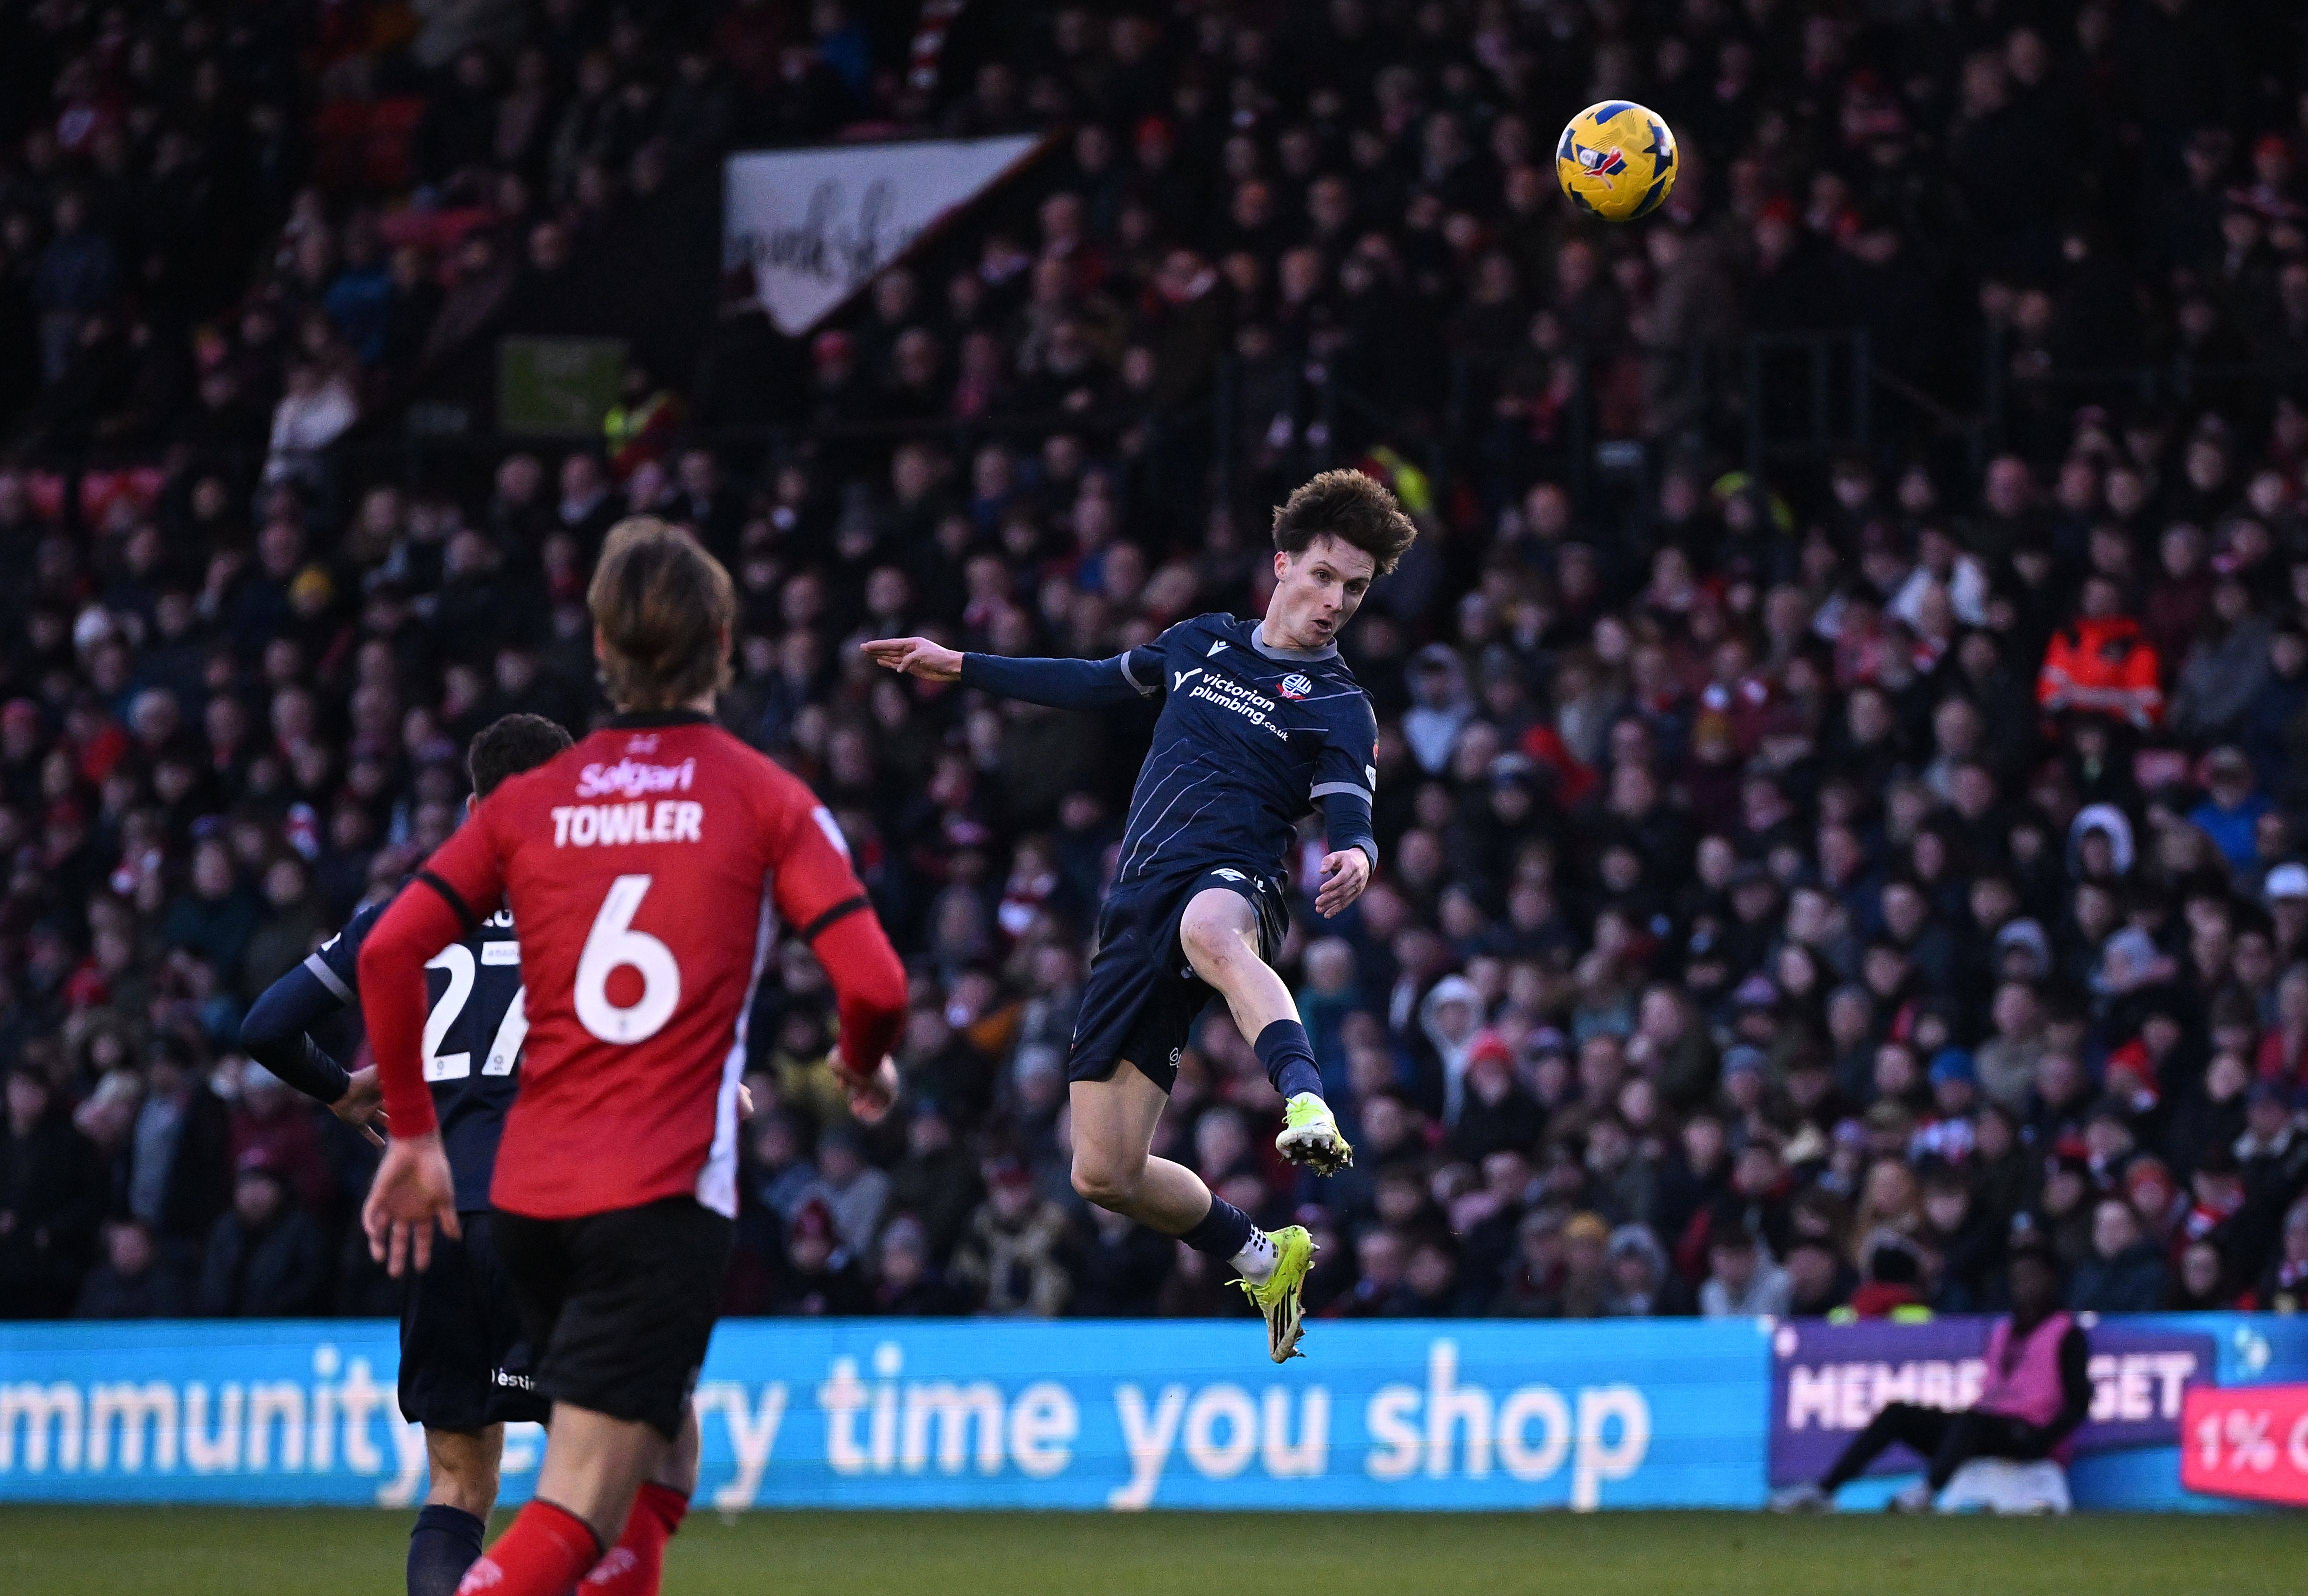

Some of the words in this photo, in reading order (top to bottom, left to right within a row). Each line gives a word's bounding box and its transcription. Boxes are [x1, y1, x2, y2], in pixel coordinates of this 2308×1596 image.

[1188, 686, 1288, 741] plumbing.co.uk
[1203, 674, 1275, 711] victorian
[551, 800, 703, 847] TOWLER
[573, 873, 681, 1045] 6
[421, 943, 529, 1083] 27
[816, 1341, 1079, 1479] time
[1107, 1382, 1331, 1512] you
[1366, 1338, 1651, 1513] shop
[2198, 1409, 2279, 1473] 1%
